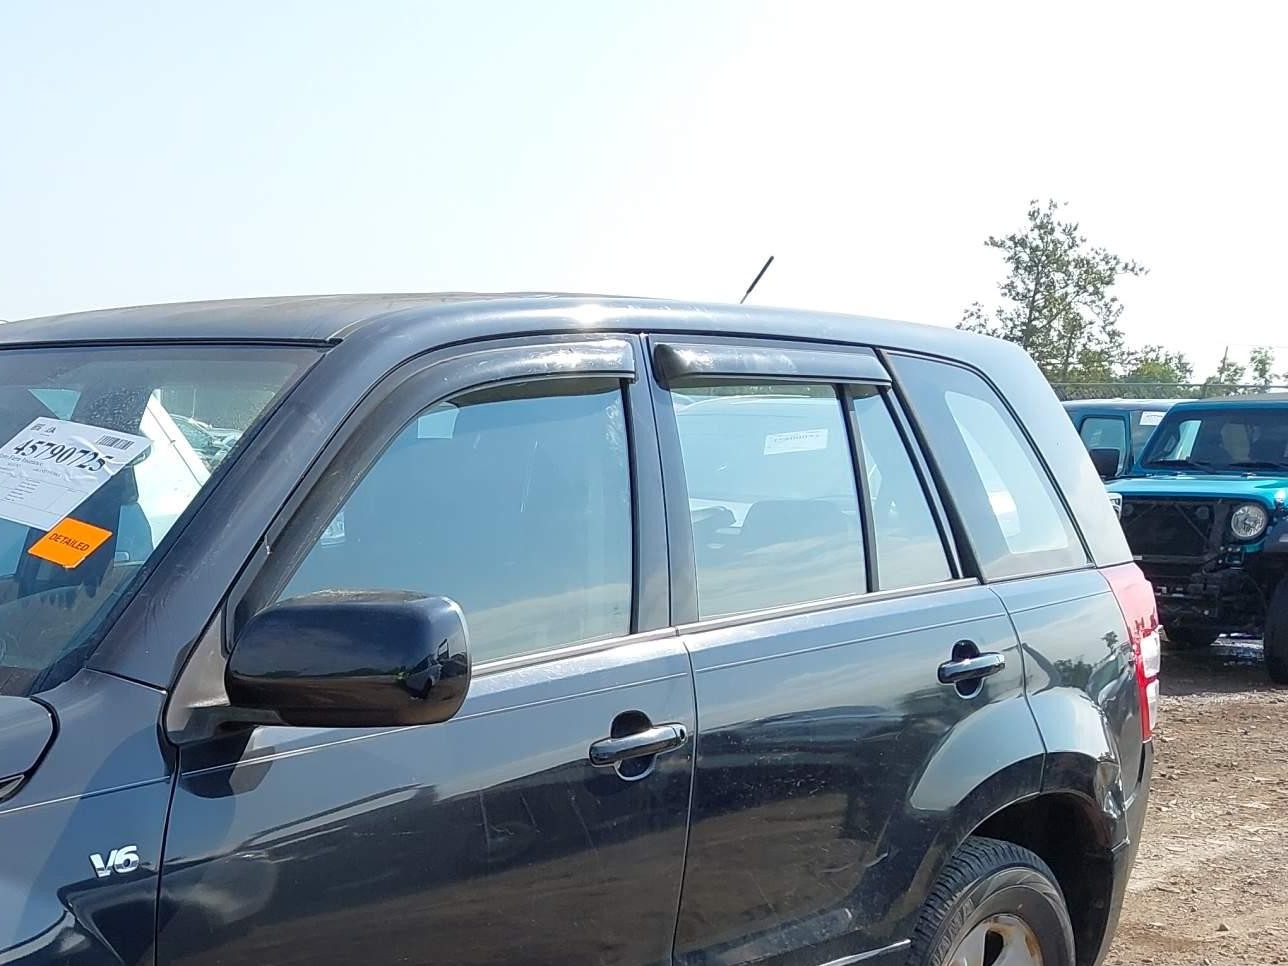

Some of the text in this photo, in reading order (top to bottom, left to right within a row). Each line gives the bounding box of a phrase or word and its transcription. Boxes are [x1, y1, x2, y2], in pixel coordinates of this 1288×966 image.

[13, 439, 114, 472] 45790725
[48, 533, 90, 551] DETAILED
[90, 845, 140, 877] V6
